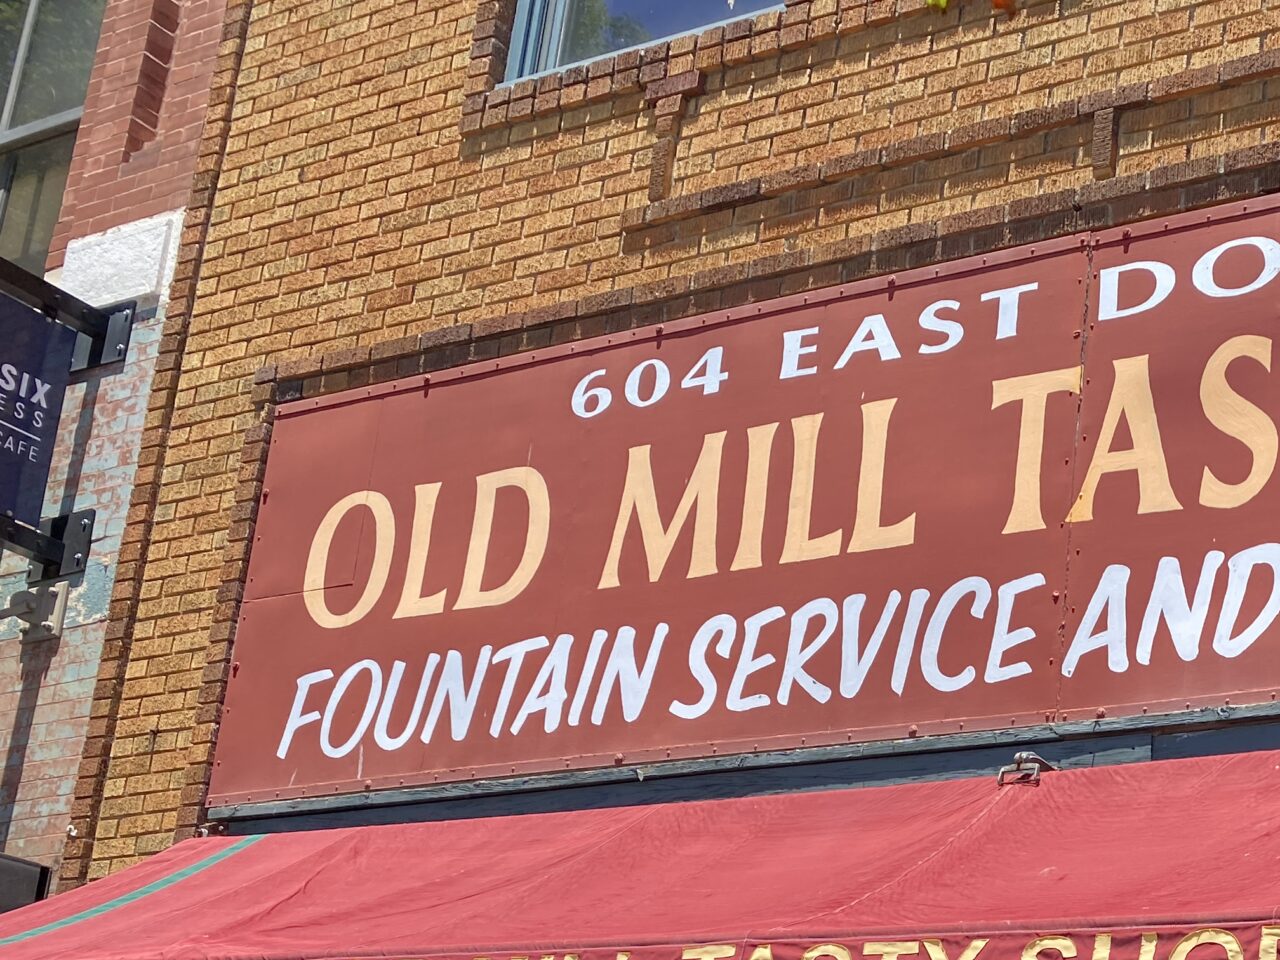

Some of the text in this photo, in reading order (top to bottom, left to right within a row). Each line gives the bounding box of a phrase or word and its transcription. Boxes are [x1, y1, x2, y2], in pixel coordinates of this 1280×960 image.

[572, 347, 729, 419] 604
[780, 281, 1039, 380] EAST
[303, 466, 551, 630] OLD
[597, 397, 917, 590] MILL
[276, 622, 670, 761] FOUNTAIN
[668, 571, 1046, 720] SERVICE
